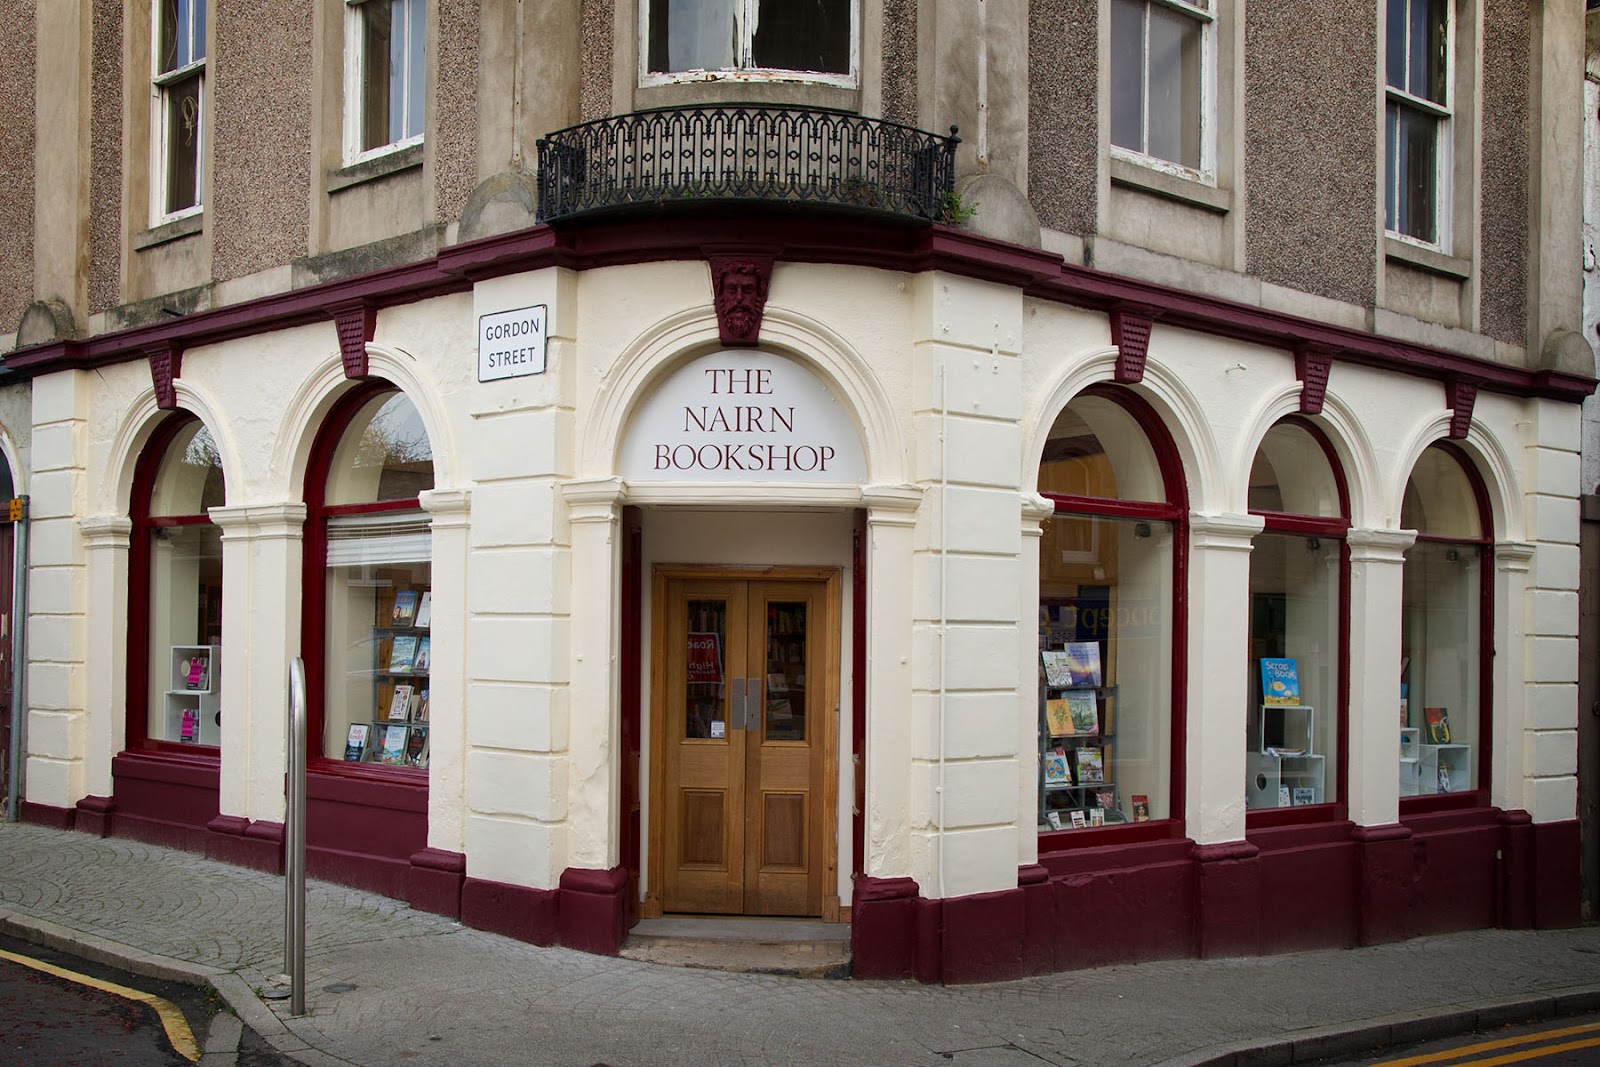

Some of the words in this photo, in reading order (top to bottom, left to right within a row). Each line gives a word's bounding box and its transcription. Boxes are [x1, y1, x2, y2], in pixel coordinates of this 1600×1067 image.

[485, 317, 540, 342] GORDON
[488, 347, 535, 369] STREET
[705, 369, 774, 395] THE
[684, 406, 796, 433] NAIRN
[654, 444, 836, 472] BOOKSHOP
[1265, 661, 1289, 670] Scrap
[1274, 670, 1294, 678] Book
